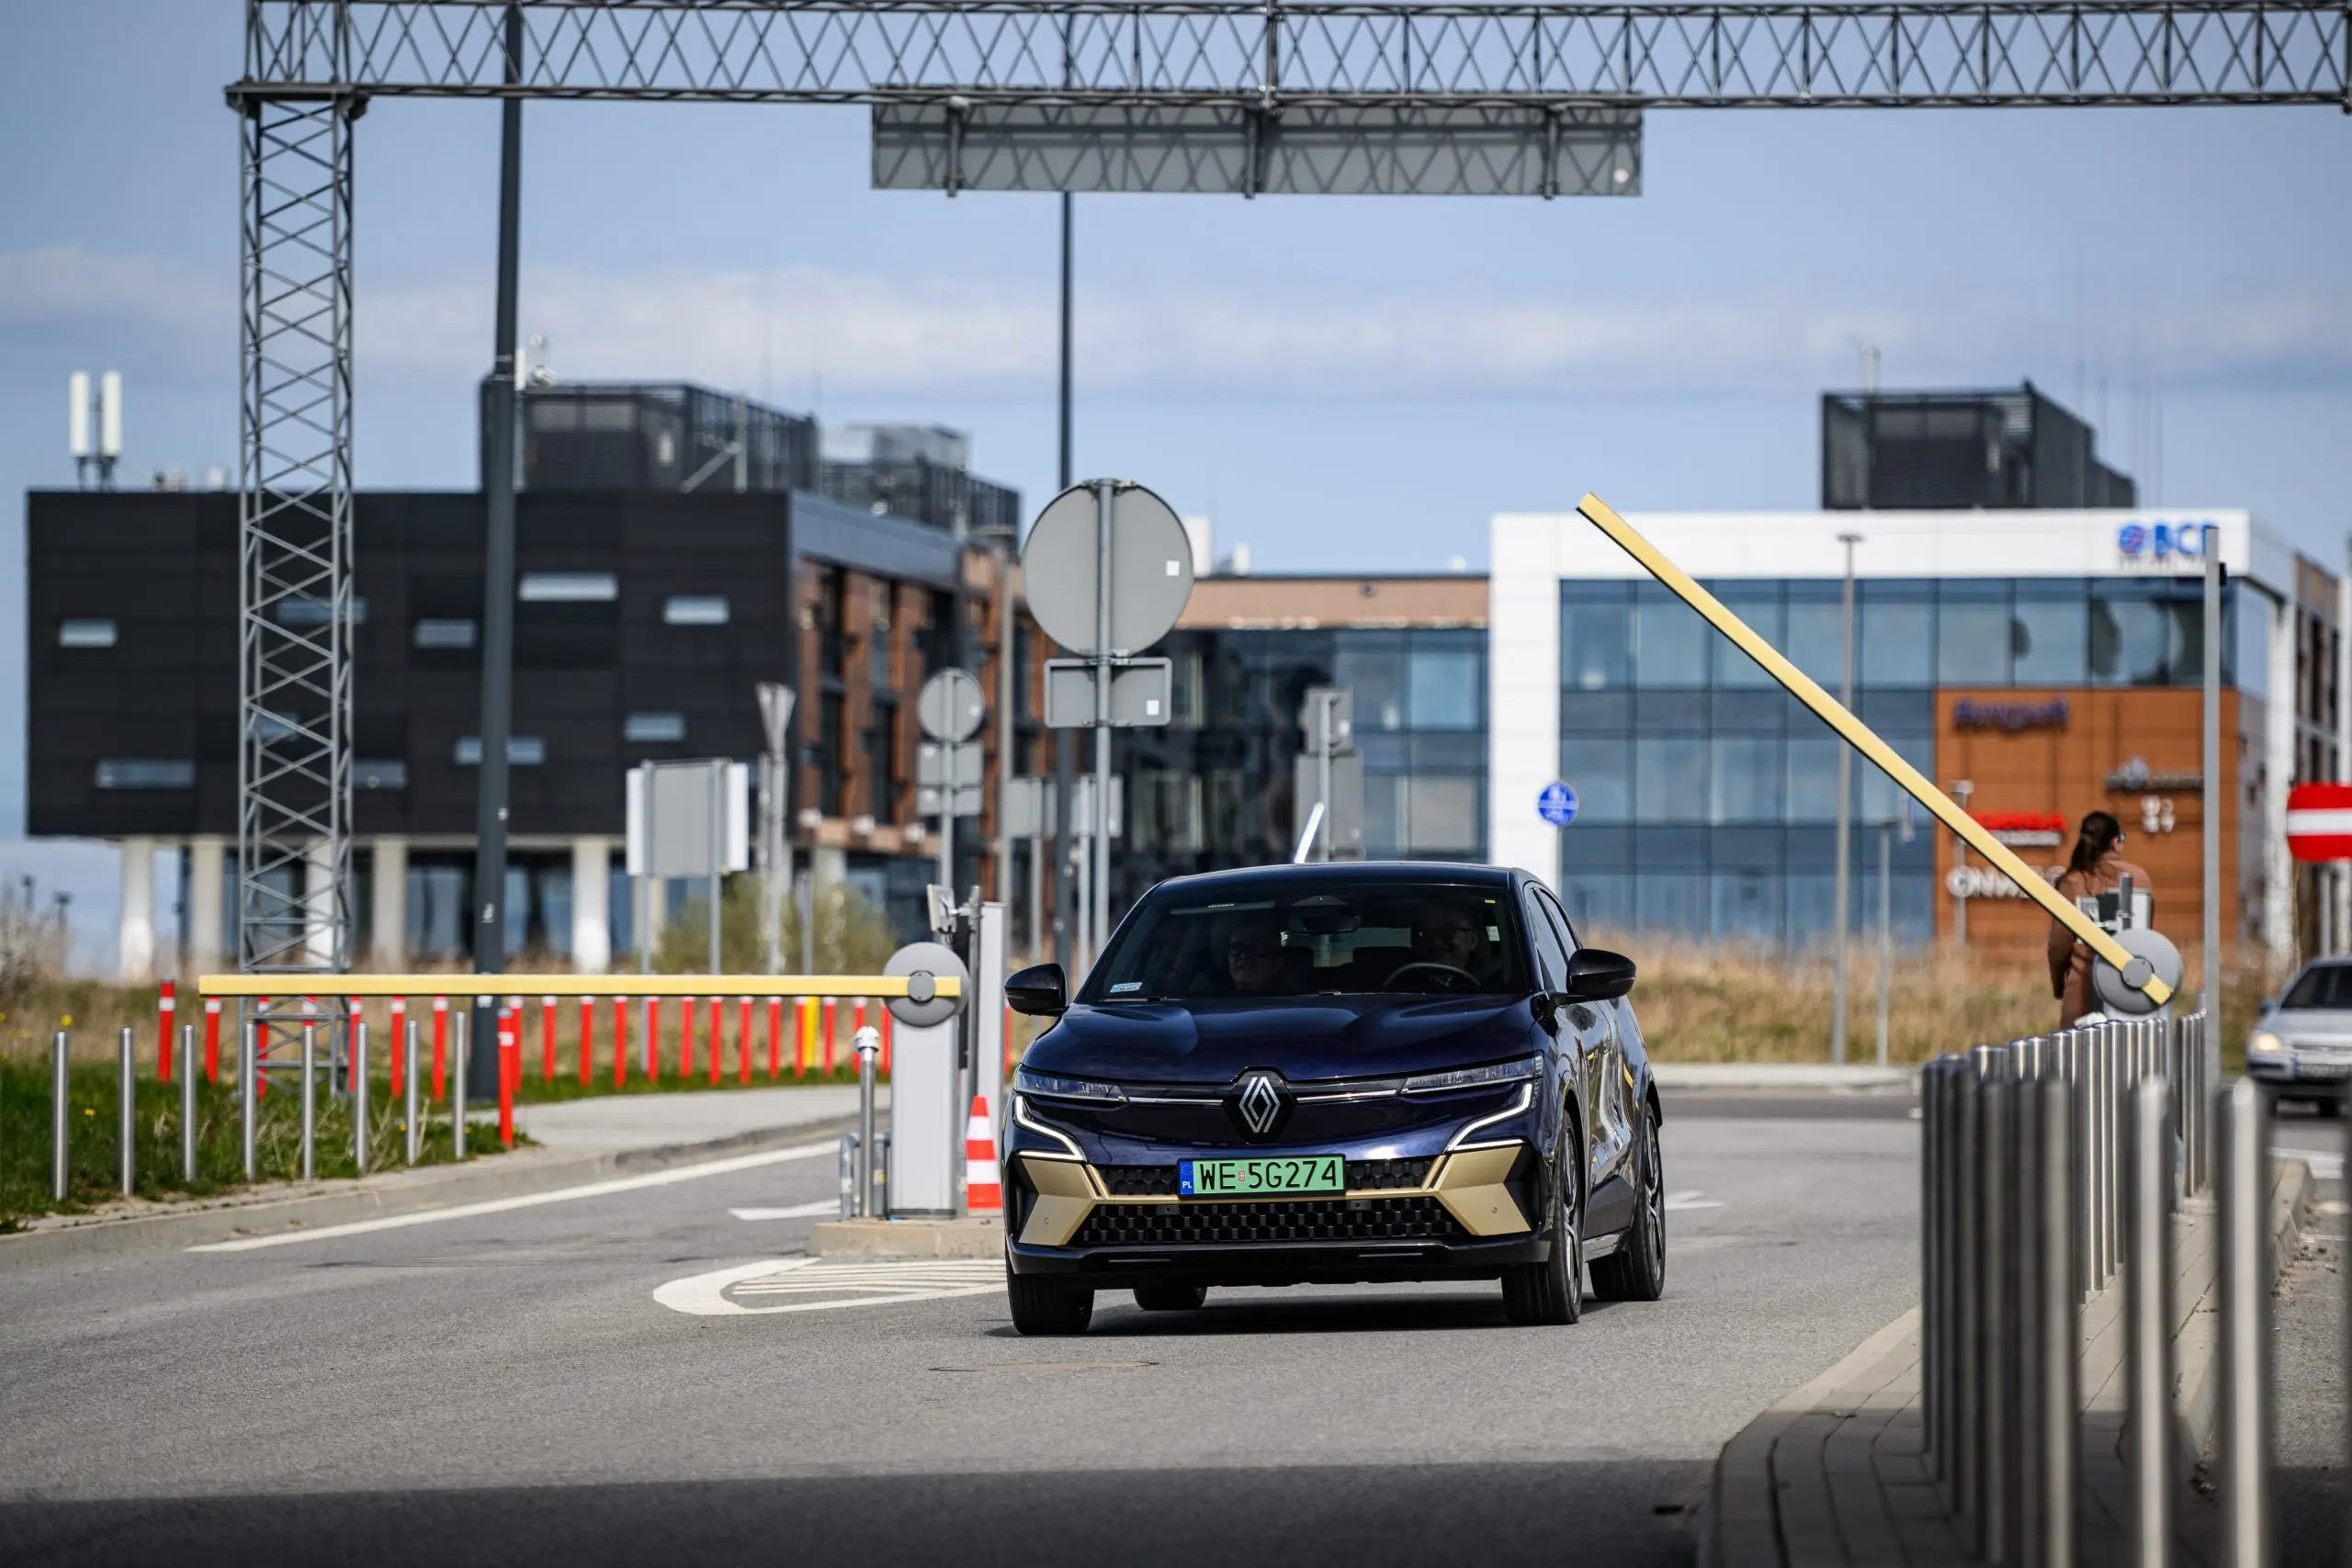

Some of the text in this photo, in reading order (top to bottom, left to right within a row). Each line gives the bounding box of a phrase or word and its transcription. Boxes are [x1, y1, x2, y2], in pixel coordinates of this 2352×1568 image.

[1199, 1159, 1337, 1190] WE 5G274
[1182, 1180, 1193, 1190] PL
